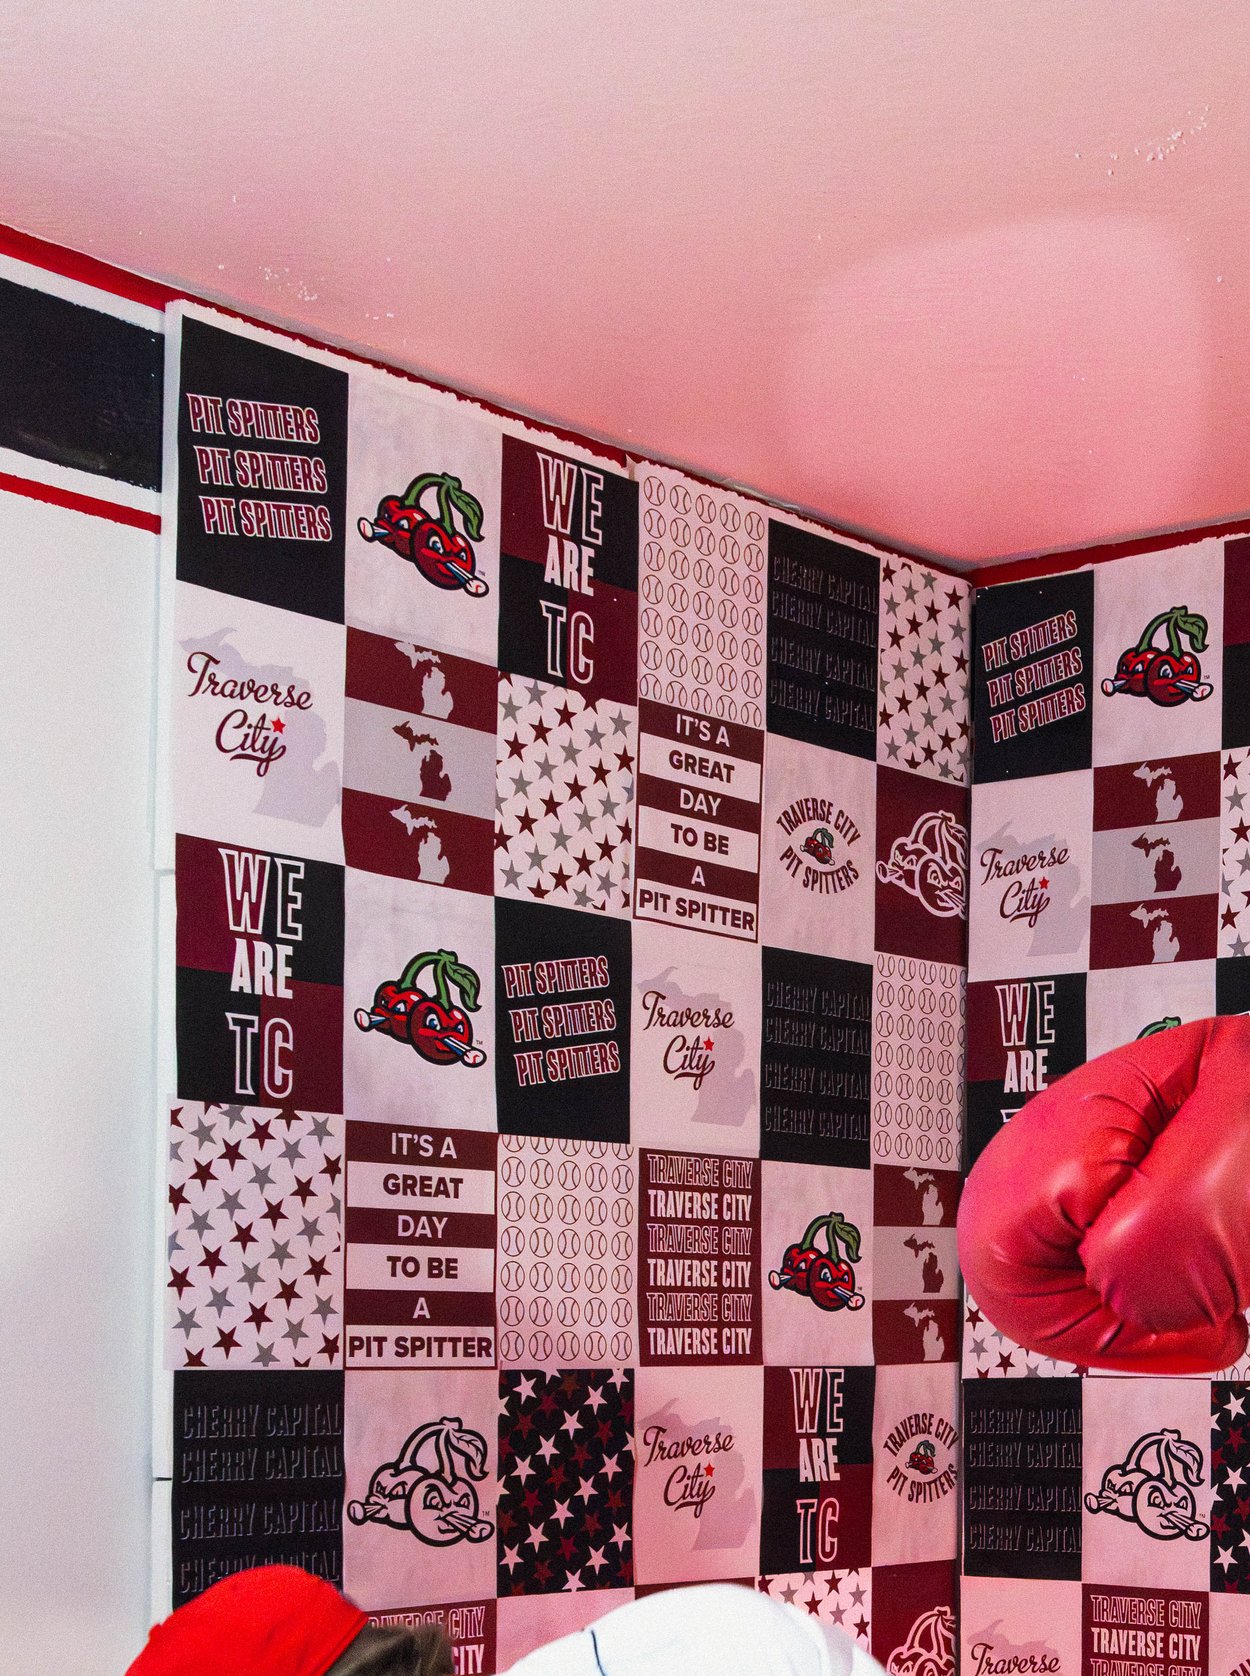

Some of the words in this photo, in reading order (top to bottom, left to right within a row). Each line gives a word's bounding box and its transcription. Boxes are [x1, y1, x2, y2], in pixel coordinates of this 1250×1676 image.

[187, 393, 226, 435] PIT
[228, 398, 320, 443] SPITTERS
[194, 446, 231, 486] PIT
[236, 450, 327, 493] SPITTERS
[200, 495, 238, 535] PIT
[240, 500, 333, 541] SPITTERS
[538, 452, 603, 545] WE
[544, 535, 595, 597] ARE
[542, 600, 594, 685] TC
[982, 638, 1007, 671] PIT
[1010, 610, 1077, 654] SPITTERS
[187, 652, 313, 710] Traverse
[987, 674, 1012, 708] PIT
[1014, 646, 1082, 692] SPITTERS
[675, 713, 712, 743] IT'S
[715, 727, 730, 748] A
[990, 710, 1016, 743] PIT
[1018, 683, 1085, 730] SPITTERS
[215, 710, 287, 777] City
[669, 752, 735, 783] GREAT
[679, 790, 722, 817] DAY
[776, 797, 834, 838] TRAVERSE
[834, 807, 864, 847] CITY
[671, 823, 698, 848] TO
[703, 831, 729, 854] BE
[691, 866, 706, 887] A
[779, 845, 802, 874] PIT
[802, 858, 860, 895] SPITTERS
[980, 845, 1070, 886] Traverse
[219, 848, 305, 941] WE
[639, 888, 671, 913] PIT
[675, 898, 755, 931] SPITTER
[999, 880, 1051, 928] City
[230, 938, 294, 1000] ARE
[502, 962, 532, 998] PIT
[535, 956, 610, 994] SPITTERS
[509, 1006, 540, 1043] PIT
[542, 999, 616, 1037] SPITTERS
[642, 990, 735, 1032] Traverse
[994, 980, 1056, 1047] WE
[225, 1012, 294, 1099] TC
[513, 1050, 545, 1087] PIT
[548, 1041, 620, 1080] SPITTERS
[663, 1034, 716, 1091] City
[1004, 1048, 1047, 1095] ARE
[390, 1133, 437, 1157] IT'S
[440, 1137, 458, 1158] A
[382, 1174, 463, 1200] GREAT
[647, 1153, 719, 1185] TRAVERSE
[722, 1160, 753, 1189] CITY
[397, 1216, 448, 1238] DAY
[647, 1189, 718, 1221] TRAVERSE
[722, 1193, 752, 1222] CITY
[386, 1256, 422, 1278] TO
[427, 1257, 459, 1279] BE
[647, 1258, 718, 1287] TRAVERSE
[722, 1261, 752, 1288] CITY
[413, 1297, 430, 1320] A
[349, 1336, 390, 1357] PIT
[394, 1335, 493, 1360] SPITTER
[647, 1326, 718, 1355] TRAVERSE
[722, 1328, 752, 1355] CITY
[183, 1405, 259, 1438] CHERRY
[267, 1404, 342, 1437] CAPITAL
[790, 1368, 844, 1433] WE
[643, 1426, 734, 1467] Traverse
[883, 1413, 934, 1457] TRAVERSE
[934, 1417, 959, 1450] CITY
[800, 1438, 840, 1482] ARE
[663, 1463, 716, 1518] City
[886, 1465, 907, 1496] PIT
[907, 1464, 958, 1503] SPITTERS
[797, 1498, 838, 1563] TC
[450, 1606, 486, 1640] CITY
[1090, 1595, 1165, 1625] TRAVERSE
[1169, 1599, 1201, 1628] CITY
[1091, 1627, 1164, 1658] TRAVERSE
[1169, 1632, 1201, 1661] CITY
